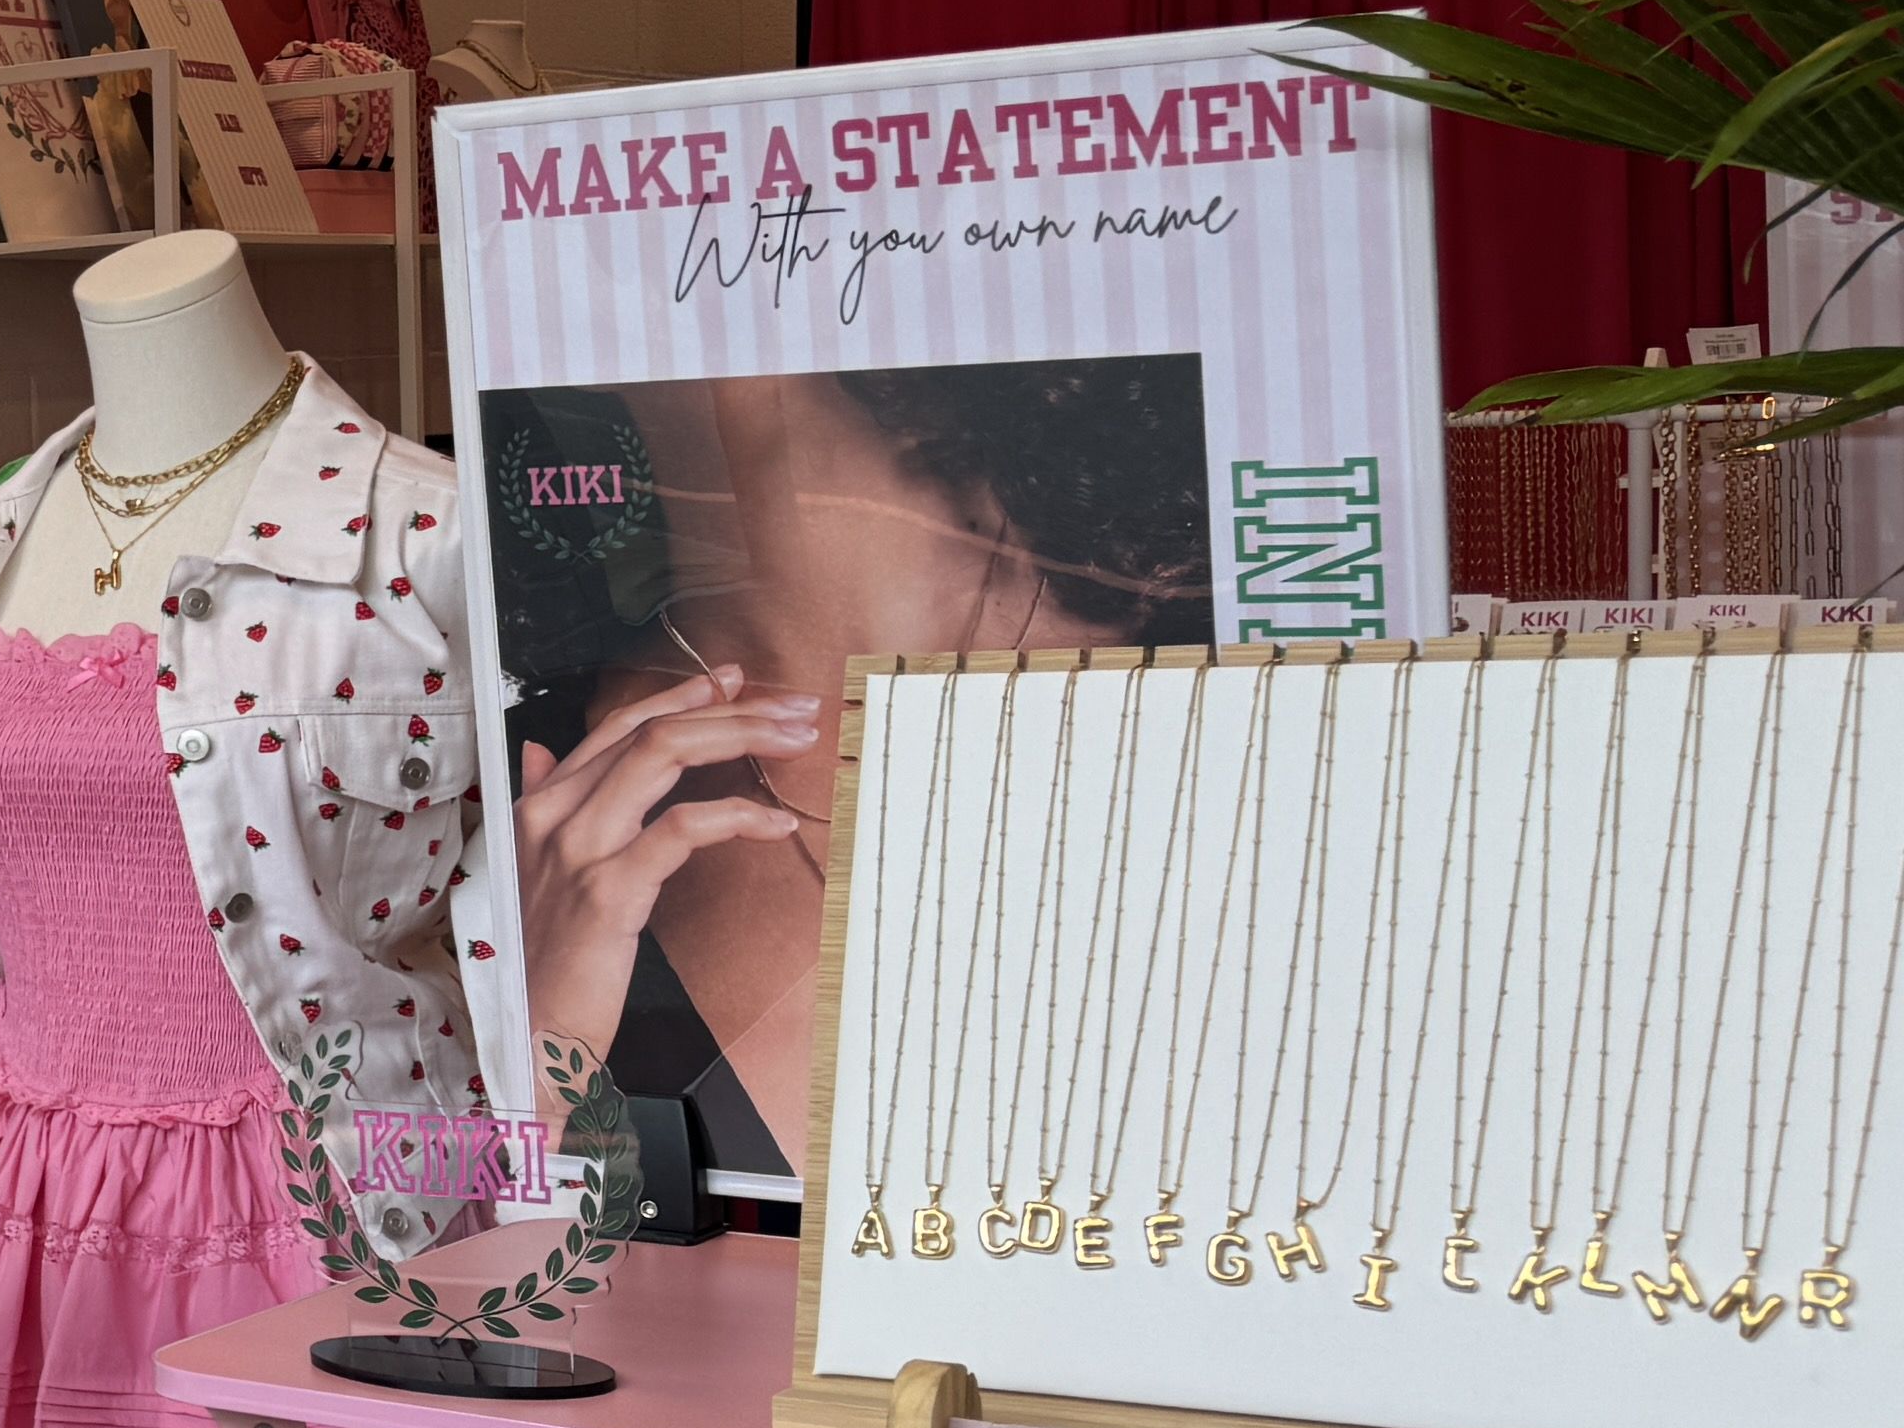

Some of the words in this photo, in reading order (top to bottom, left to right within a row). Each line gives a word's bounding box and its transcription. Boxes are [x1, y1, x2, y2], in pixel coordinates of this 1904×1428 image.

[497, 129, 731, 220] MAKE
[753, 125, 806, 200] A
[832, 76, 1370, 194] STATEMENT
[675, 184, 846, 309] With
[840, 229, 944, 325] you
[964, 219, 1076, 252] own
[1094, 195, 1239, 242] name
[528, 465, 624, 510] KIKI
[1521, 611, 1568, 627] KIKI
[1605, 607, 1653, 624] KIKI
[1709, 604, 1745, 616] KIKI
[1822, 604, 1873, 623] KIKI
[353, 1109, 551, 1205] KIKI
